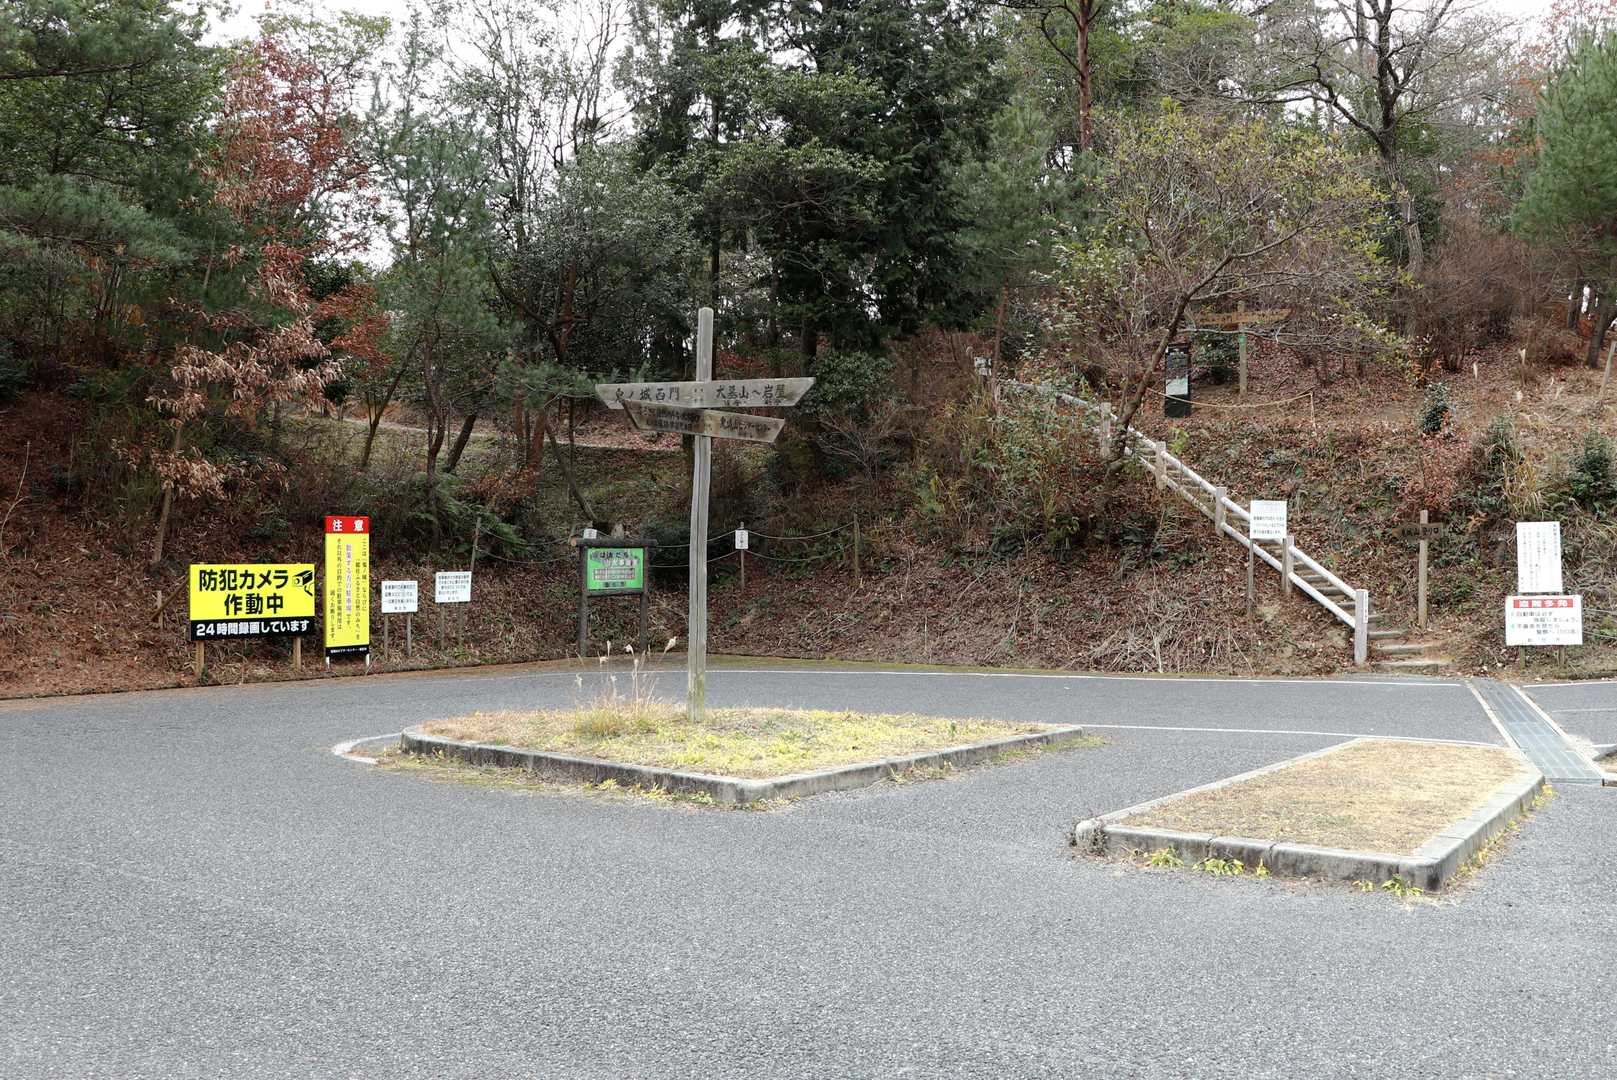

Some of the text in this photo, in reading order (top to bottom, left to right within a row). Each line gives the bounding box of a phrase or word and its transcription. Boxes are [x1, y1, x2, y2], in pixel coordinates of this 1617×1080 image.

[199, 569, 289, 592] 防犯カメラ
[224, 592, 284, 616] 作動中
[196, 620, 310, 636] 24時間録画しています
